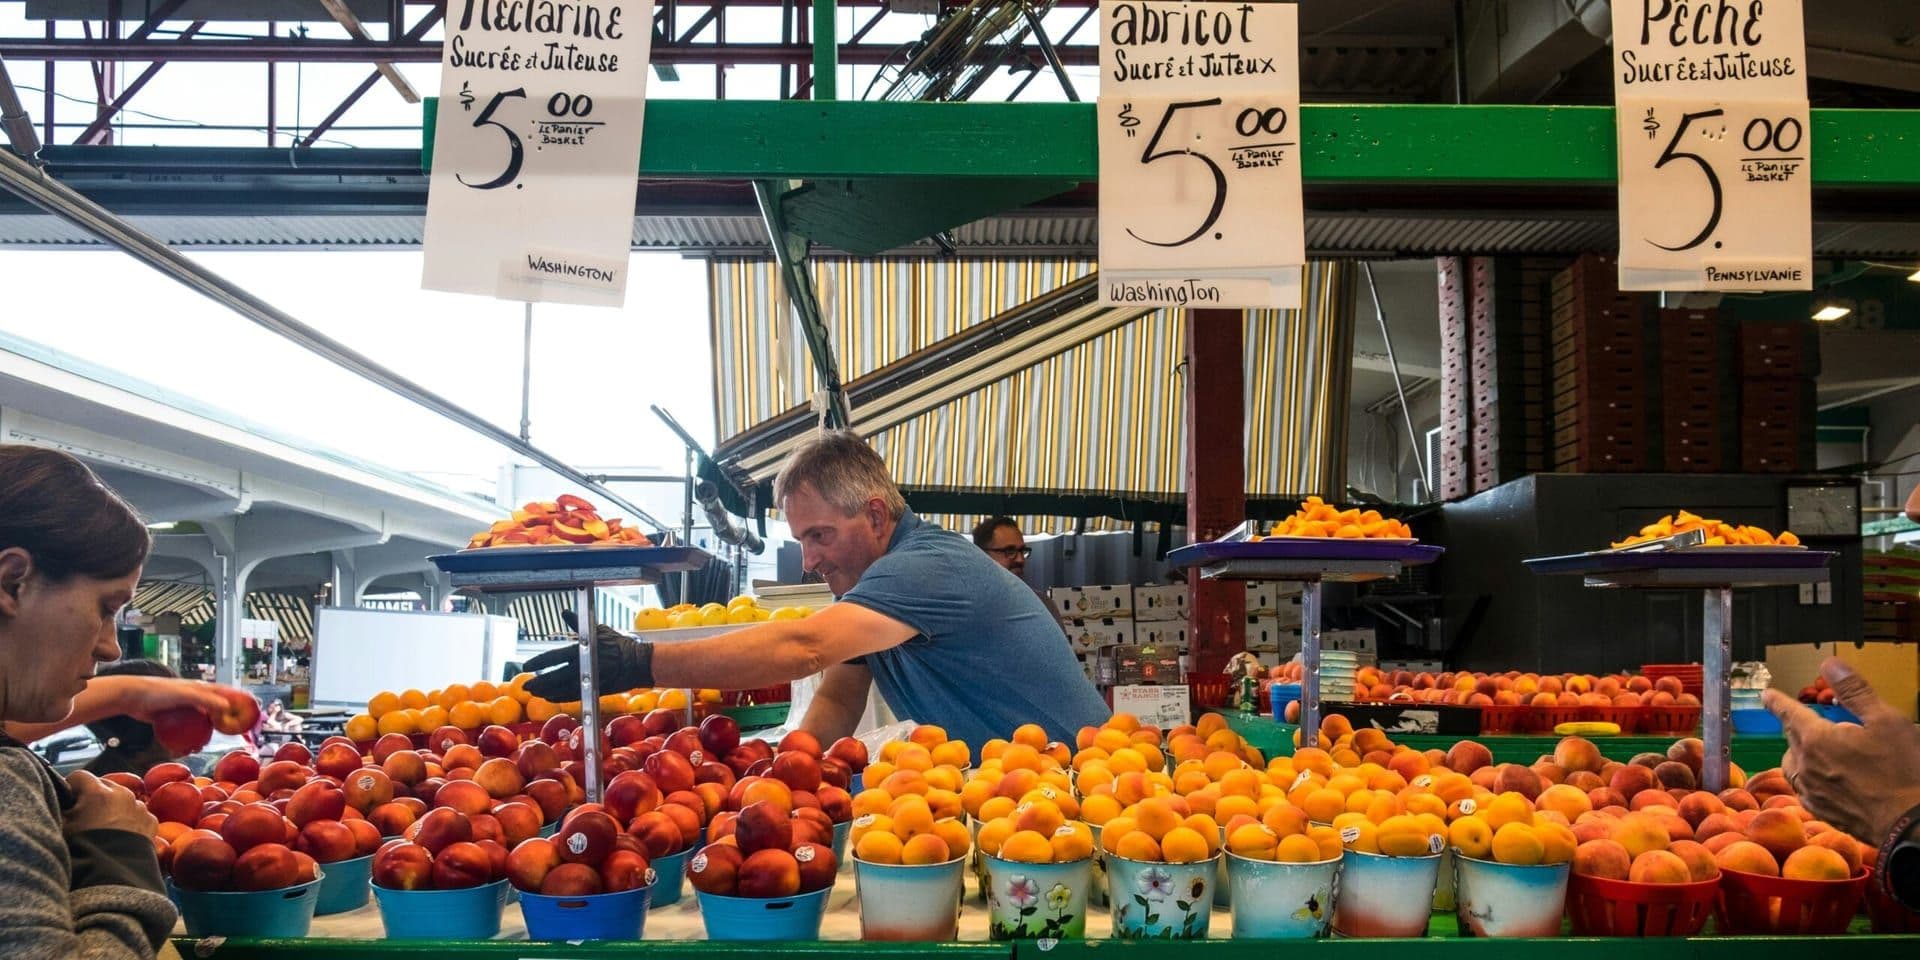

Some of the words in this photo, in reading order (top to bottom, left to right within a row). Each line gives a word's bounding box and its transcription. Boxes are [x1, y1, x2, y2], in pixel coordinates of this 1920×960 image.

[1111, 2, 1254, 46] abricot
[1641, 0, 1763, 47] Pêche
[450, 34, 521, 71] Sucrée
[525, 50, 538, 69] et
[1113, 48, 1174, 82] Sucré
[1179, 55, 1194, 77] et
[1622, 50, 1698, 84] Sucrée
[1700, 58, 1713, 80] et
[551, 124, 594, 135] Panier
[1244, 149, 1284, 158] Panier
[1754, 161, 1800, 171] Panier
